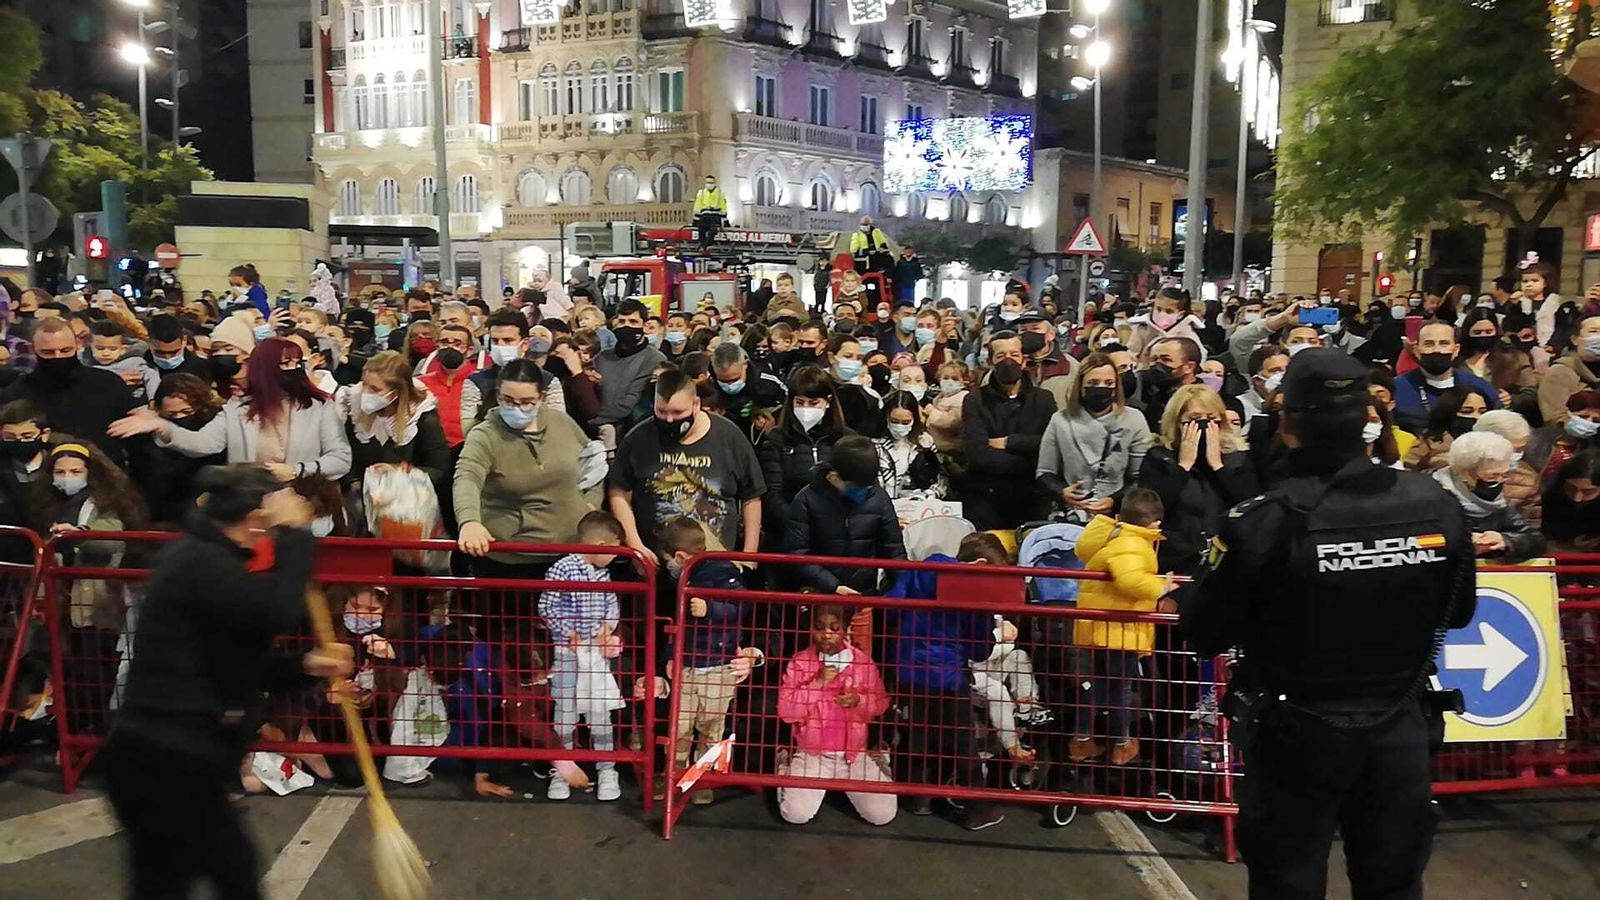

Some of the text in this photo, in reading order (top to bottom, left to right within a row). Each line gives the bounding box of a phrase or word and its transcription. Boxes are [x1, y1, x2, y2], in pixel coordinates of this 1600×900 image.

[691, 230, 792, 243] BBEROS ALMERIA
[1316, 536, 1422, 558] POLICIA
[1318, 549, 1447, 572] NACIONAL
